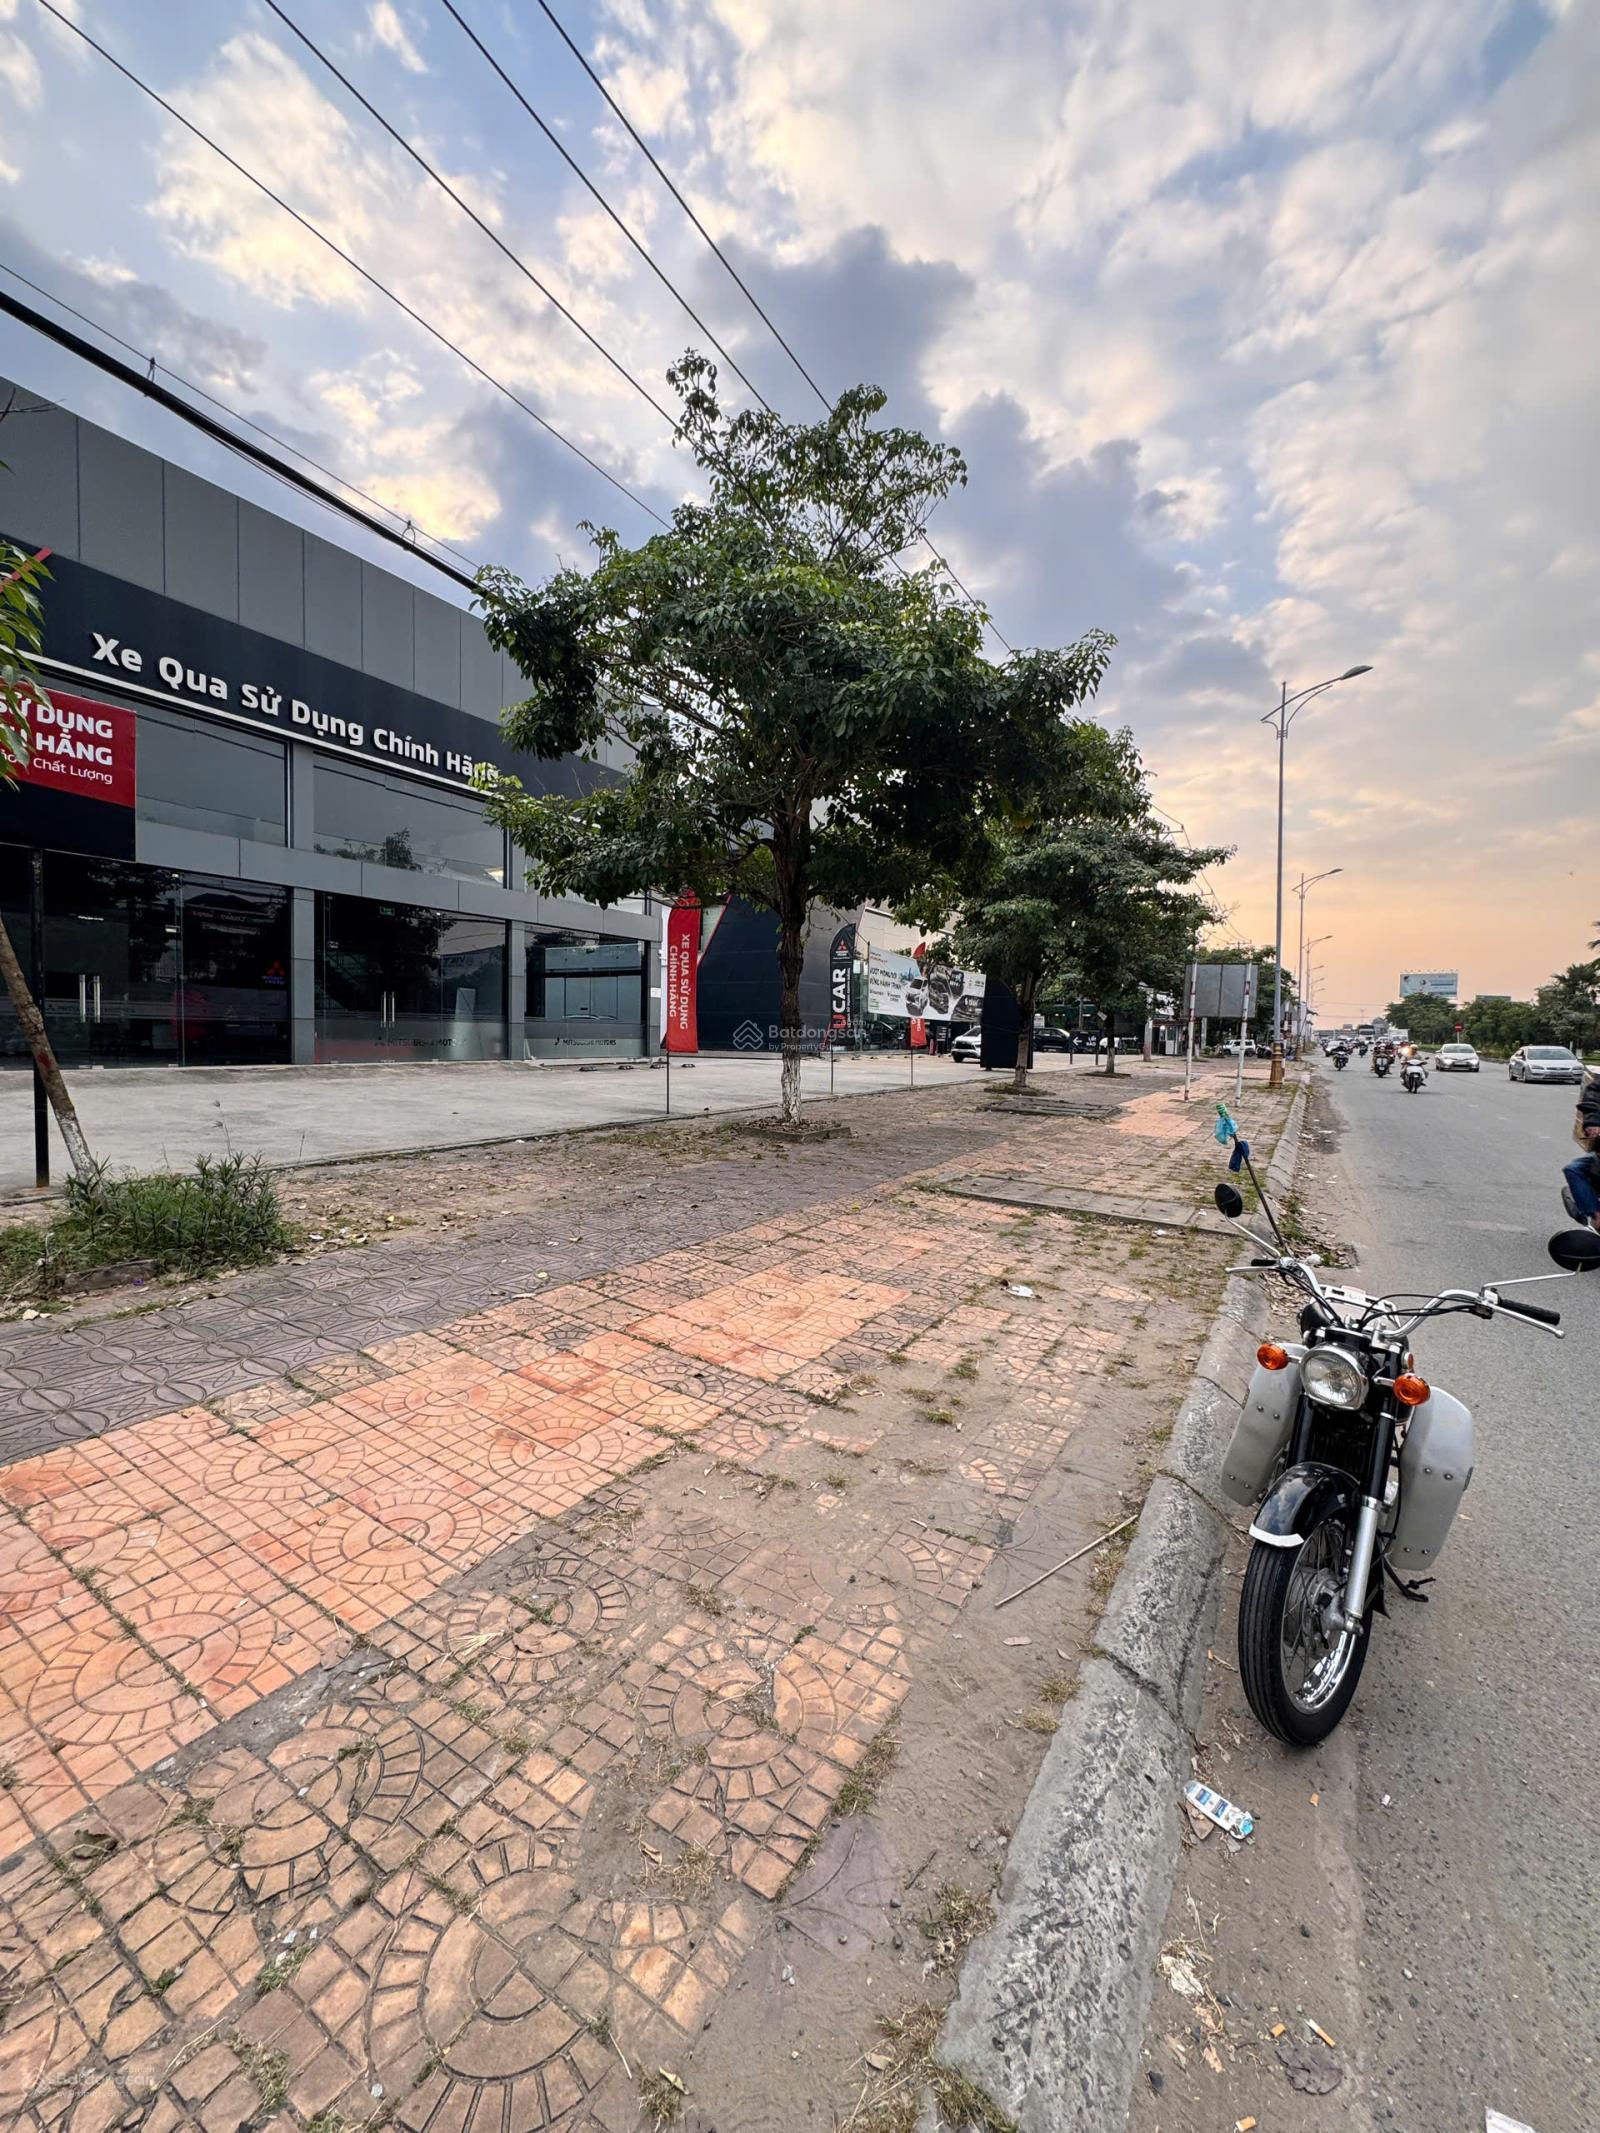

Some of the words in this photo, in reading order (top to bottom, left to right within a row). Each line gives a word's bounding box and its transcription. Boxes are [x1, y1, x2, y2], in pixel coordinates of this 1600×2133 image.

[92, 632, 143, 672] Xe
[158, 656, 228, 700] Qua
[241, 684, 282, 716] Sử
[291, 699, 364, 746] Dụng
[373, 728, 439, 766] Chính
[36, 703, 113, 739] DỤNG
[36, 732, 113, 766] HÃNG
[33, 757, 67, 774] Chất
[70, 765, 113, 785] Lượng
[681, 933, 691, 949] XE
[669, 945, 678, 982] CHÍNH
[679, 952, 690, 977] QUA
[669, 982, 679, 1018] HÃNG
[680, 978, 692, 995] SỬ
[679, 995, 689, 1030] DỤNG
